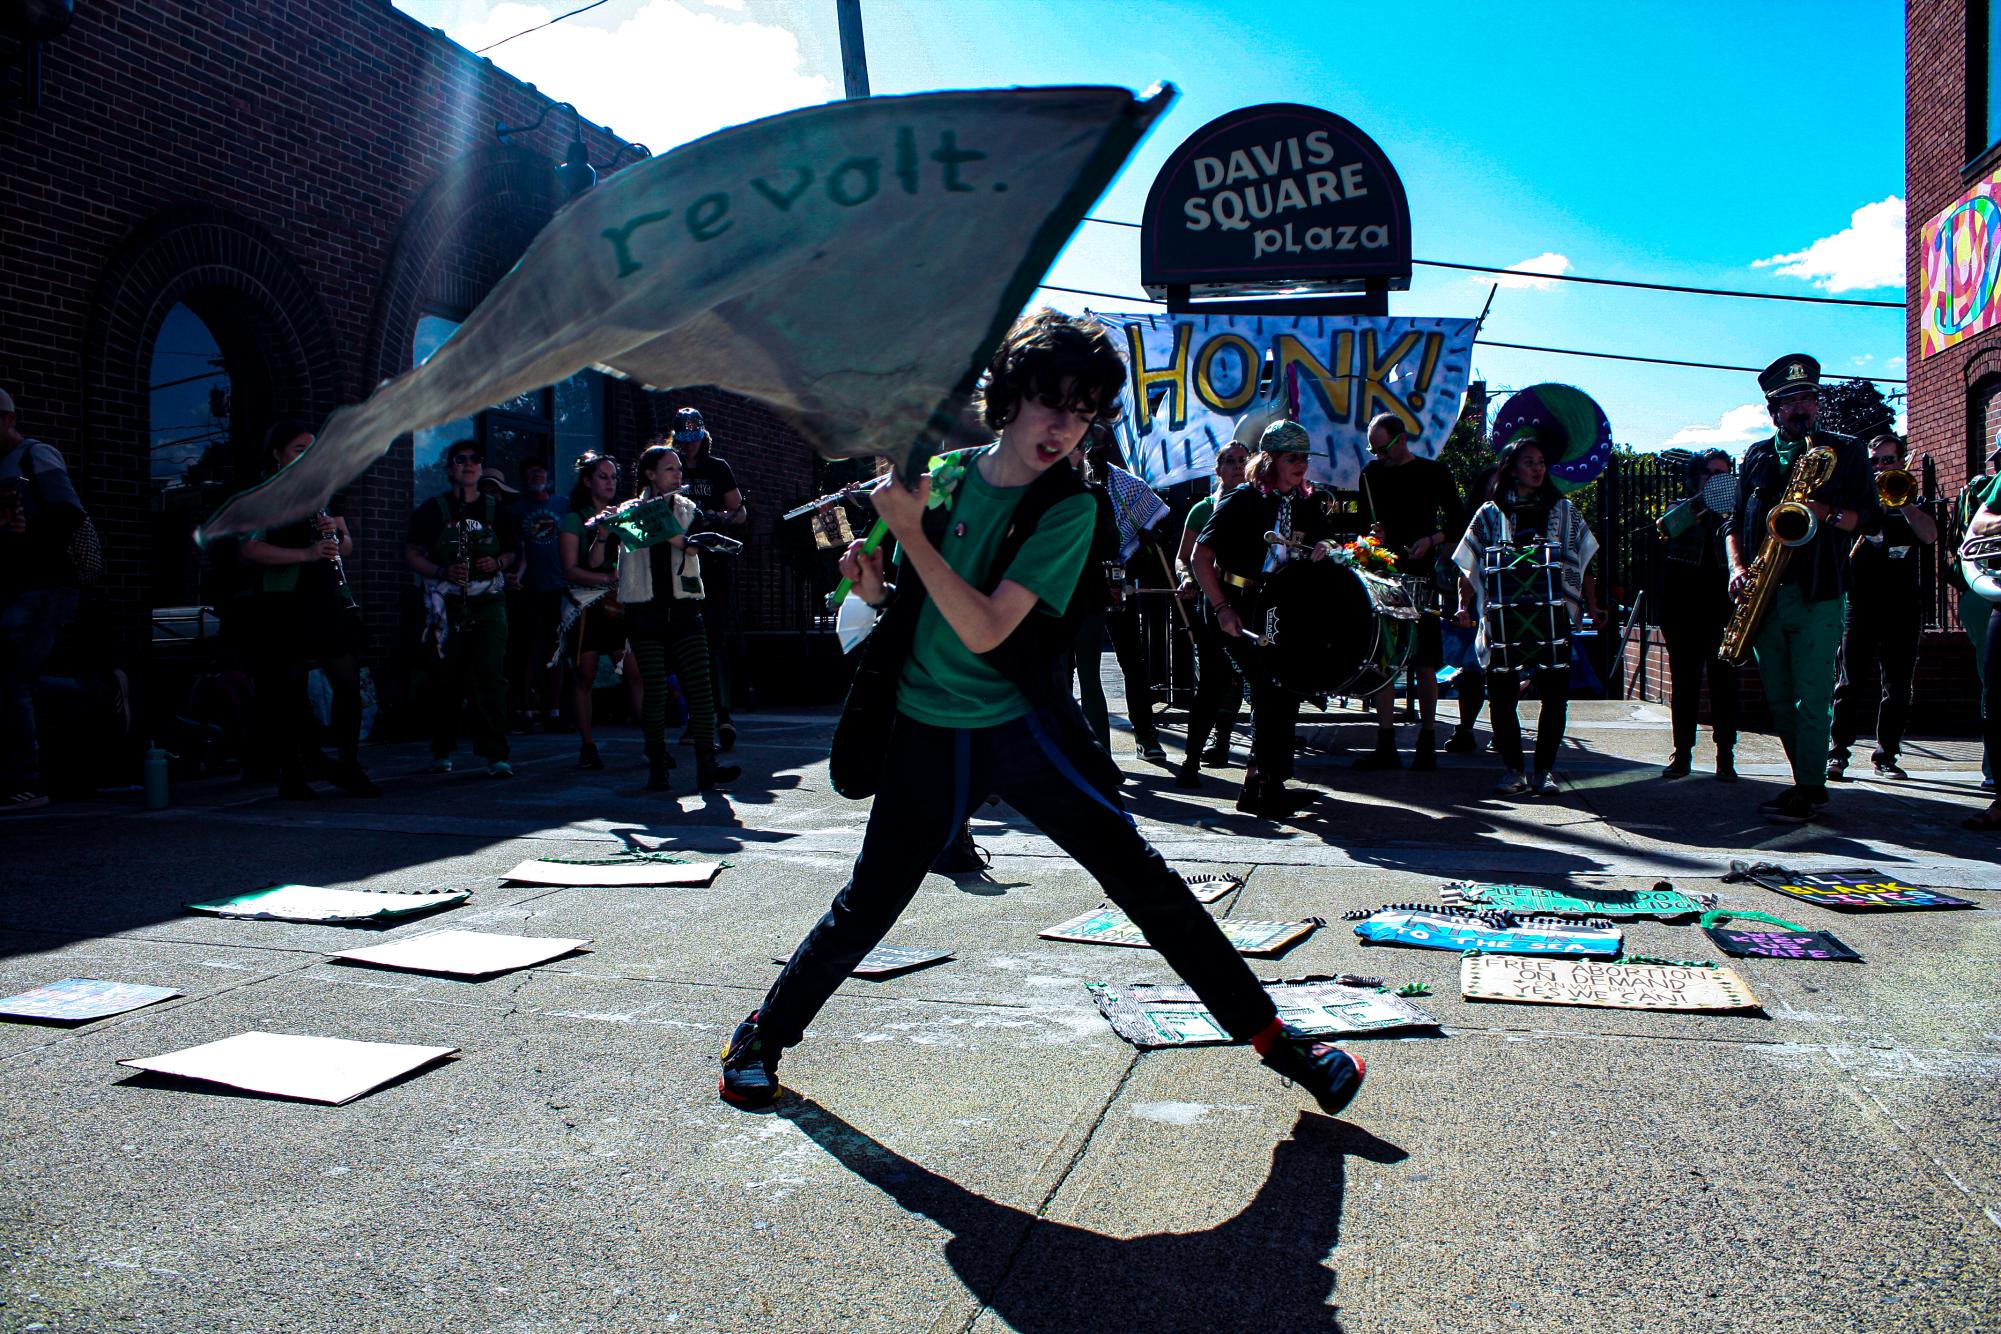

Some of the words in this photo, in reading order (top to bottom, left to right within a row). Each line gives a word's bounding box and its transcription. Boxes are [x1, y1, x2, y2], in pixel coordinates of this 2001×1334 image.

[1194, 130, 1334, 190] DAVIS
[602, 126, 1009, 278] revolt.
[1183, 162, 1368, 231] SQUARE
[1124, 321, 1441, 441] HONK!
[1779, 882, 1917, 895] BLACK
[1803, 890, 1937, 902] LIVES
[1391, 926, 1430, 940] TO
[1449, 937, 1514, 949] THE
[1527, 942, 1588, 953] SEA
[1485, 958, 1552, 972] FREE
[1571, 964, 1707, 980] ABORTION
[1519, 970, 1556, 981] ON
[1571, 973, 1686, 990] DEMAND
[1513, 985, 1561, 997] YES
[1569, 988, 1608, 1000] WE
[1620, 992, 1689, 1004] CAN!
